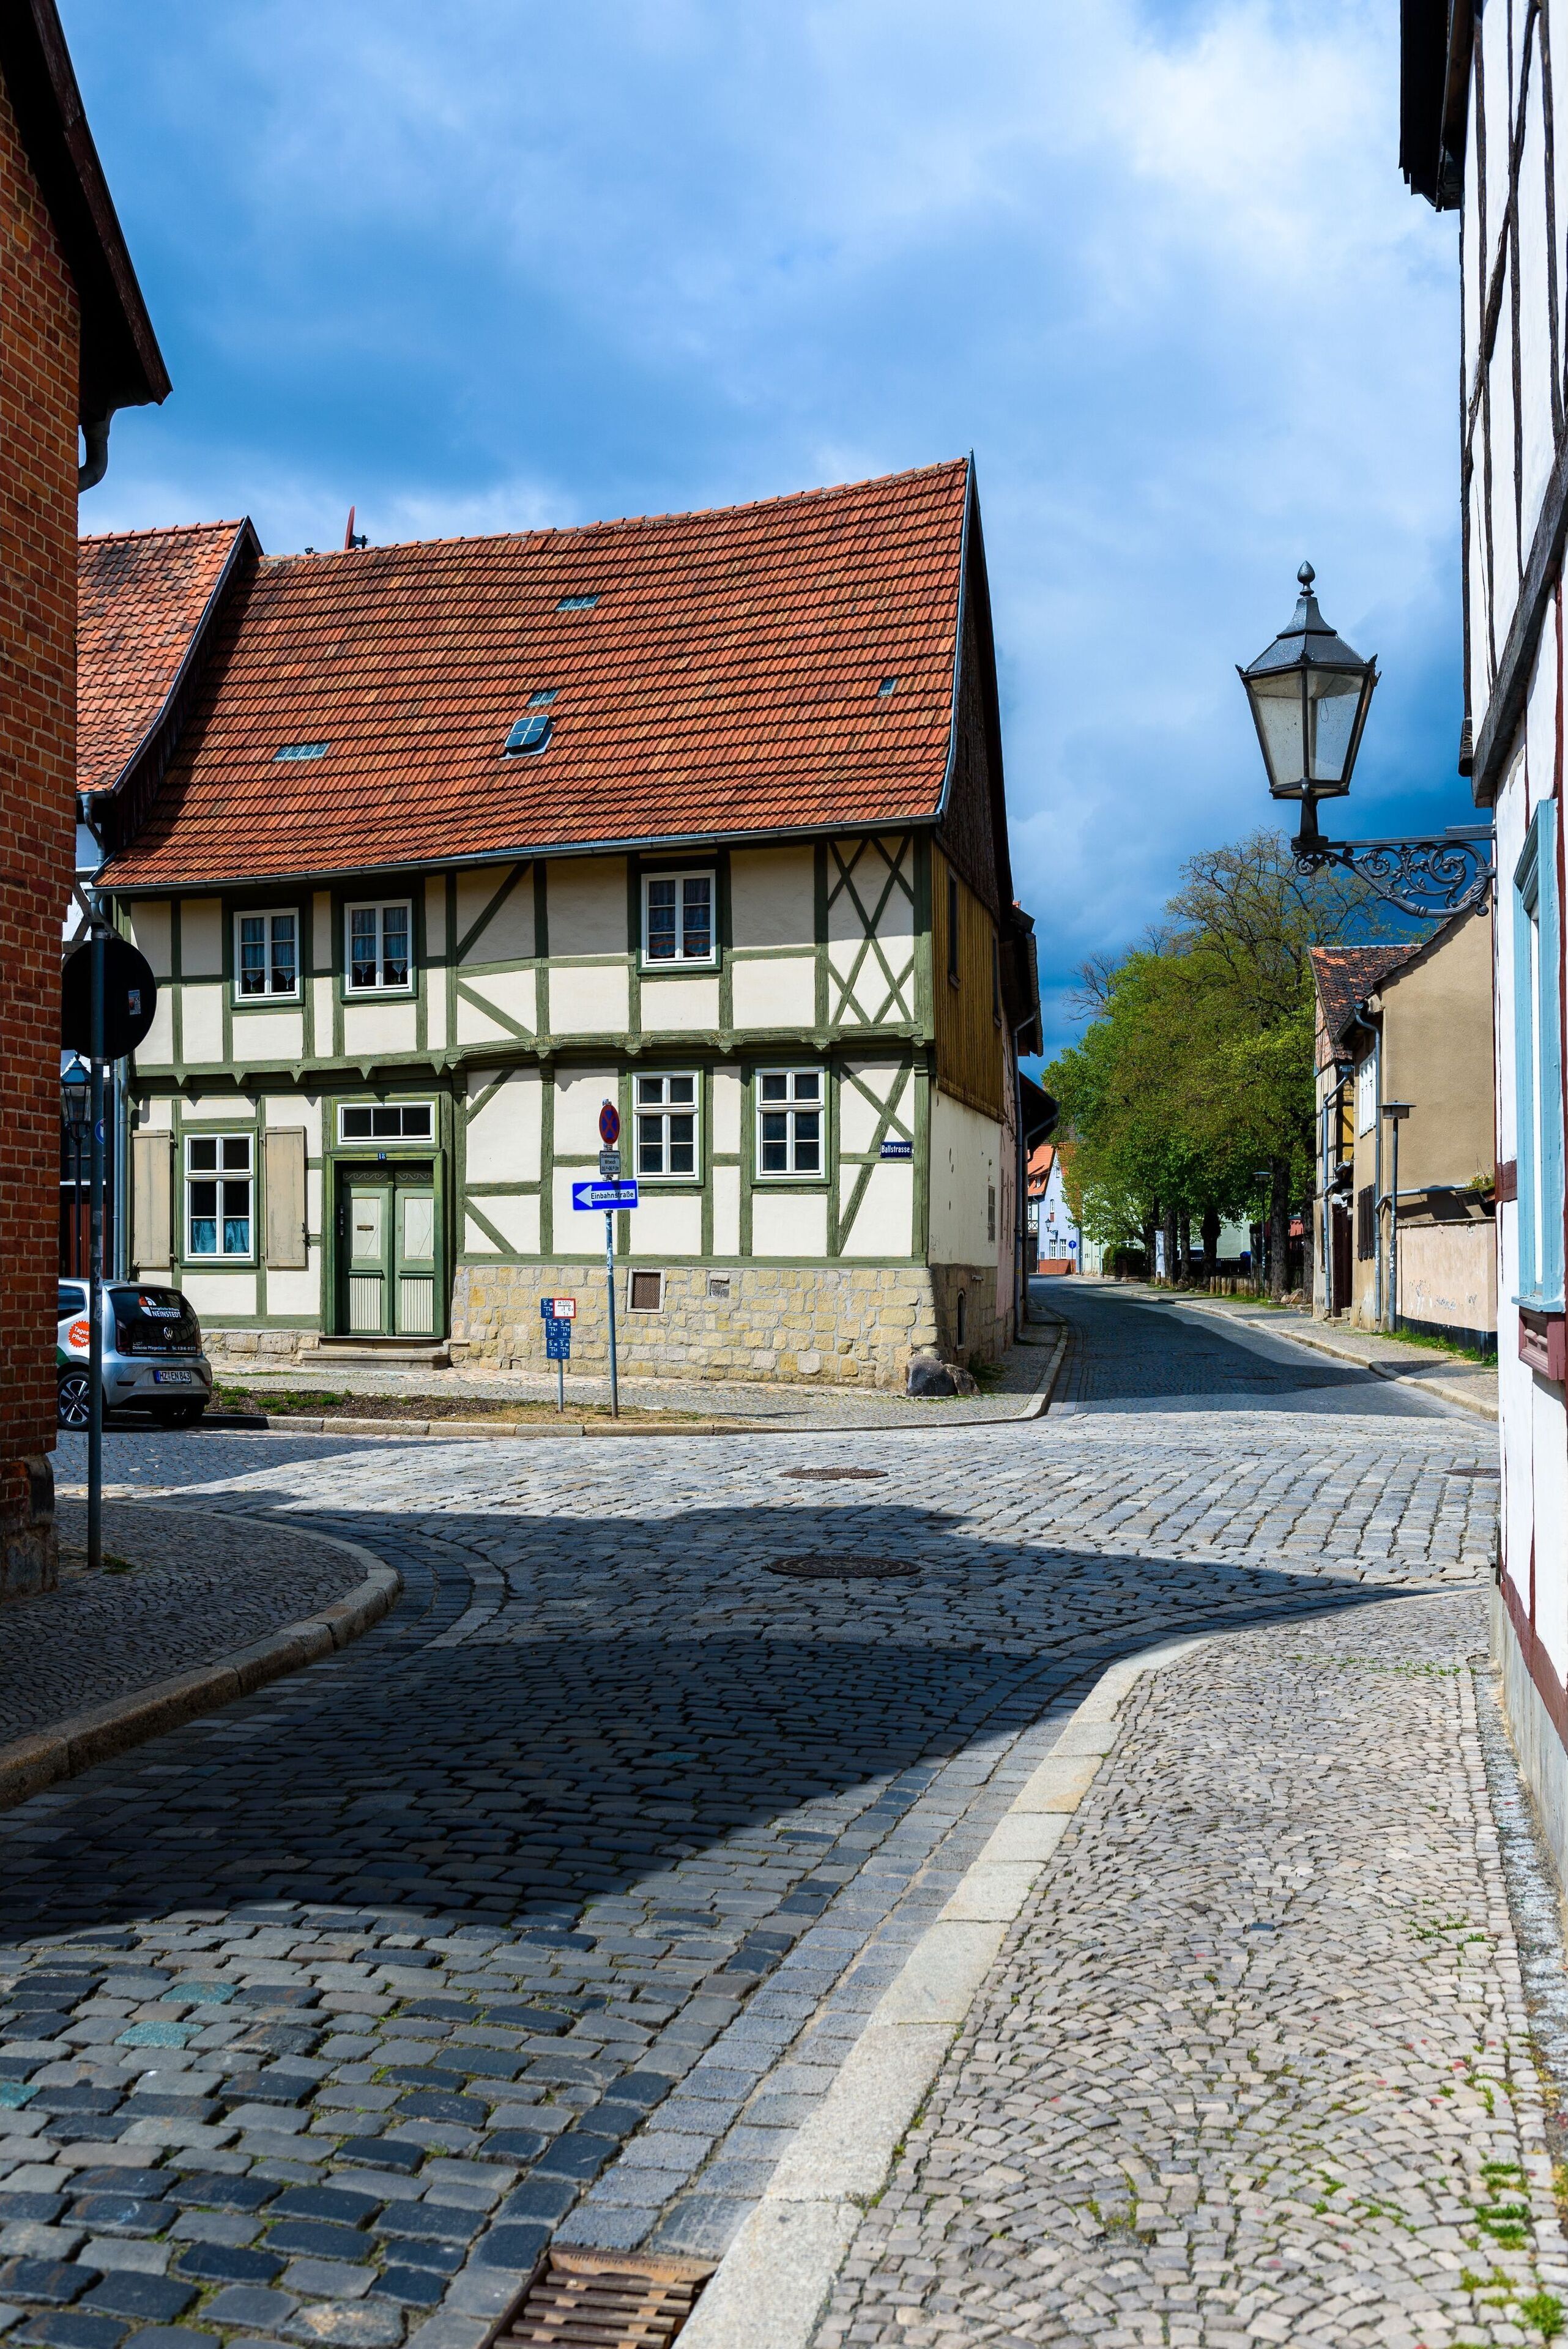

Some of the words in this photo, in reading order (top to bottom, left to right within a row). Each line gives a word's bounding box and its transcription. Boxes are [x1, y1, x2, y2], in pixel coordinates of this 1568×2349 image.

[591, 1191, 634, 1200] Einbahnstraße
[74, 1326, 89, 1335] Tages
[72, 1334, 89, 1343] Pflege
[160, 1371, 168, 1380] HZ
[171, 1371, 179, 1380] EN
[179, 1371, 190, 1380] 843
